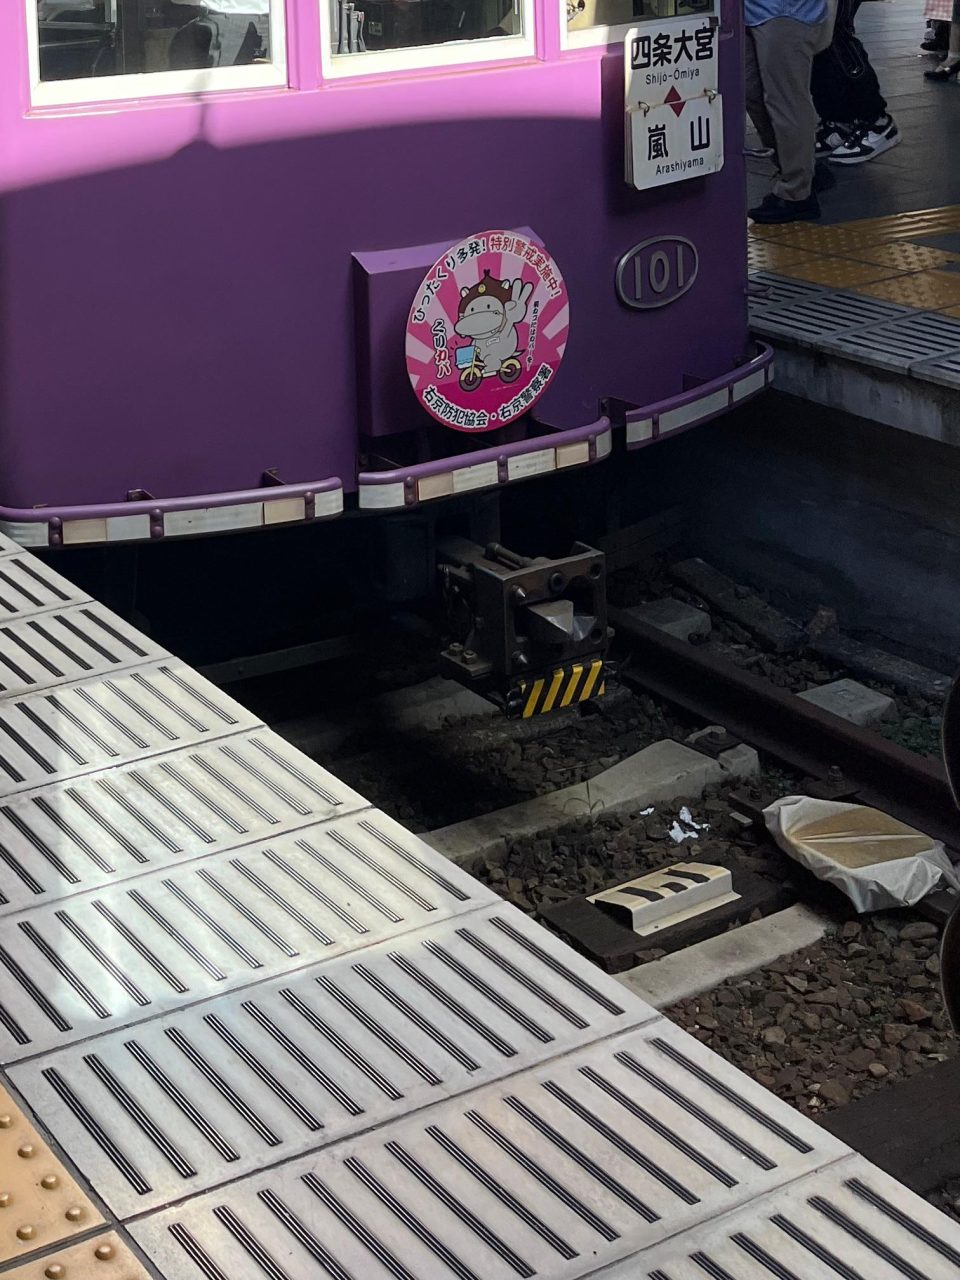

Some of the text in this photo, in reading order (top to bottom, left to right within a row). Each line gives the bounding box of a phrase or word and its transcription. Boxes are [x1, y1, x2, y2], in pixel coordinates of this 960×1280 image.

[630, 26, 715, 70] 四条大宮
[655, 156, 704, 175] Arashiyama
[634, 244, 684, 300] 101
